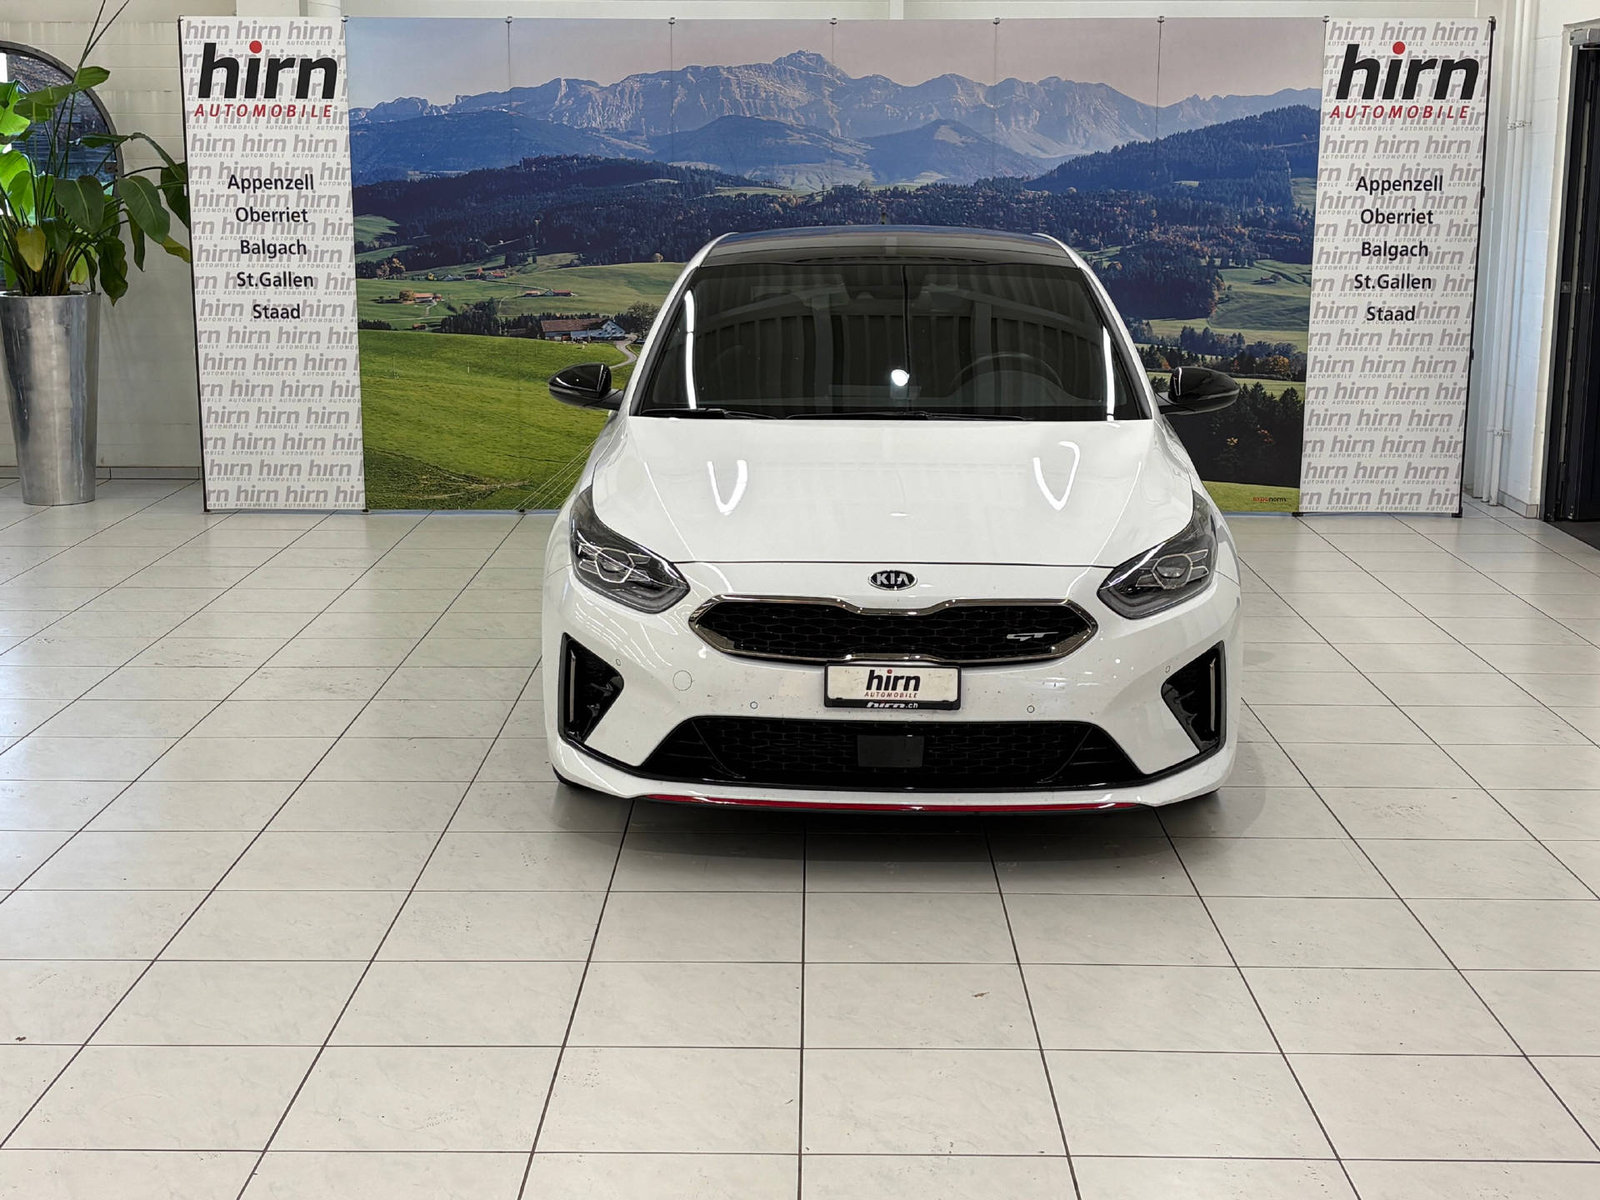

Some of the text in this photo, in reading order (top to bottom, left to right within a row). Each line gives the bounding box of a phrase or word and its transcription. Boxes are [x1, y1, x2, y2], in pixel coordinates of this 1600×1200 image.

[186, 21, 332, 39] hirn hirn hirn
[1329, 22, 1478, 40] hirn hirn hirn
[198, 41, 338, 99] hirn
[1335, 41, 1479, 100] hirn
[194, 104, 333, 118] AUTOMOBILE
[1329, 105, 1470, 118] AUTOMOBILE
[191, 134, 337, 151] hirn hirn hirn
[1324, 135, 1471, 153] hirn hirn hirn
[219, 162, 263, 179] hirn
[270, 162, 313, 179] hirn
[1348, 163, 1392, 181] hirn
[1399, 163, 1443, 181] hirn
[227, 174, 314, 193] Appenzell
[1355, 176, 1443, 195] Appenzell
[194, 190, 339, 207] hirn hirn hirn
[1320, 191, 1467, 209] hirn hirn hirn
[236, 206, 308, 223] Oberriet
[1361, 208, 1433, 224] Oberriet
[197, 245, 241, 262] hirn
[240, 239, 307, 258] Balgach
[1317, 246, 1360, 264] hirn
[1361, 241, 1428, 260] Balgach
[236, 271, 314, 287] St.Gallen
[1354, 273, 1432, 289] St.Gallen
[200, 299, 244, 316] hirn
[302, 299, 345, 316] hirn
[253, 303, 301, 319] Staad
[1314, 301, 1358, 319] hirn
[1416, 301, 1460, 319] hirn
[1366, 306, 1415, 321] Staad
[227, 326, 271, 343] hirn
[278, 326, 321, 343] hirn
[1337, 328, 1382, 346] hirn
[1388, 328, 1433, 346] hirn
[203, 353, 347, 370] hirn hirn hirn
[1311, 355, 1456, 373] hirn hirn hirn
[230, 380, 274, 397] hirn
[280, 380, 323, 397] hirn
[1334, 382, 1378, 399] hirn
[1385, 382, 1429, 399] hirn
[206, 406, 349, 423] hirn hirn hirn
[1308, 408, 1452, 426] hirn hirn hirn
[233, 433, 276, 449] hirn
[283, 433, 326, 449] hirn
[1331, 435, 1374, 452] hirn
[1382, 435, 1426, 452] hirn
[236, 485, 279, 502] hirn
[285, 485, 328, 502] hirn
[1328, 488, 1371, 505] hirn
[1379, 488, 1422, 505] hirn
[876, 572, 910, 585] KIA
[866, 669, 921, 691] hirn
[864, 691, 918, 699] AUTOMOBILE
